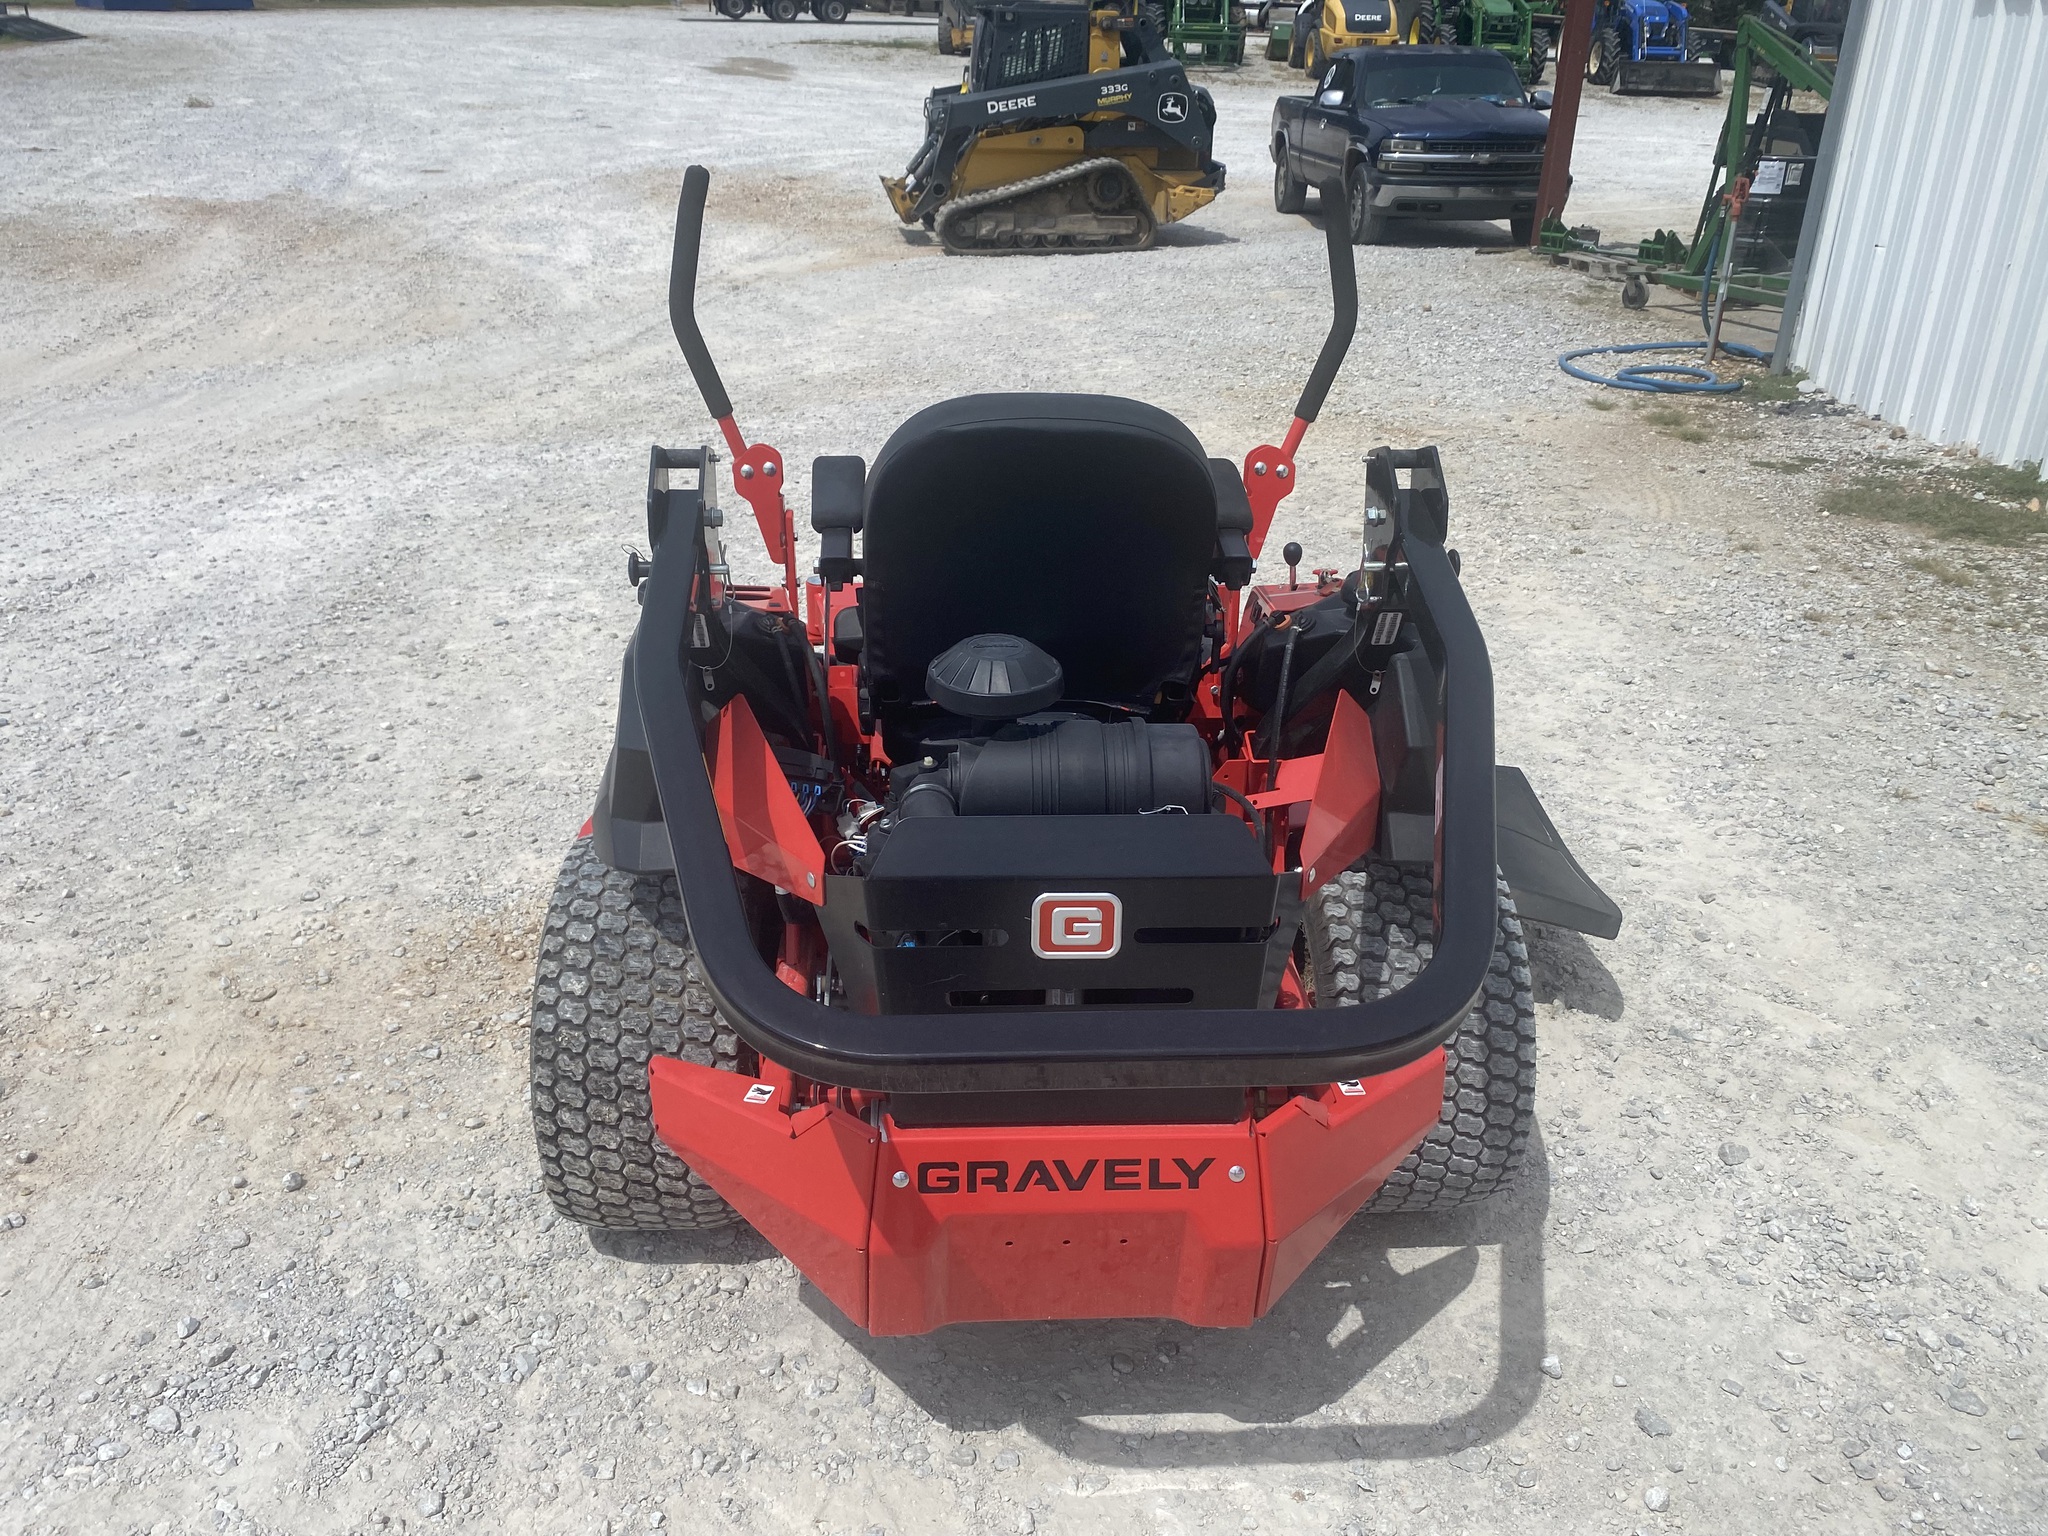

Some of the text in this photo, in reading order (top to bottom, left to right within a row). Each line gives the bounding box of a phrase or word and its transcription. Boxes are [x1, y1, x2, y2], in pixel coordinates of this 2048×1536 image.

[1354, 13, 1382, 21] DEERE
[1100, 83, 1129, 95] 333G
[986, 95, 1037, 115] DEERE
[1051, 907, 1103, 946] G
[917, 1157, 1217, 1194] GRAVELY
